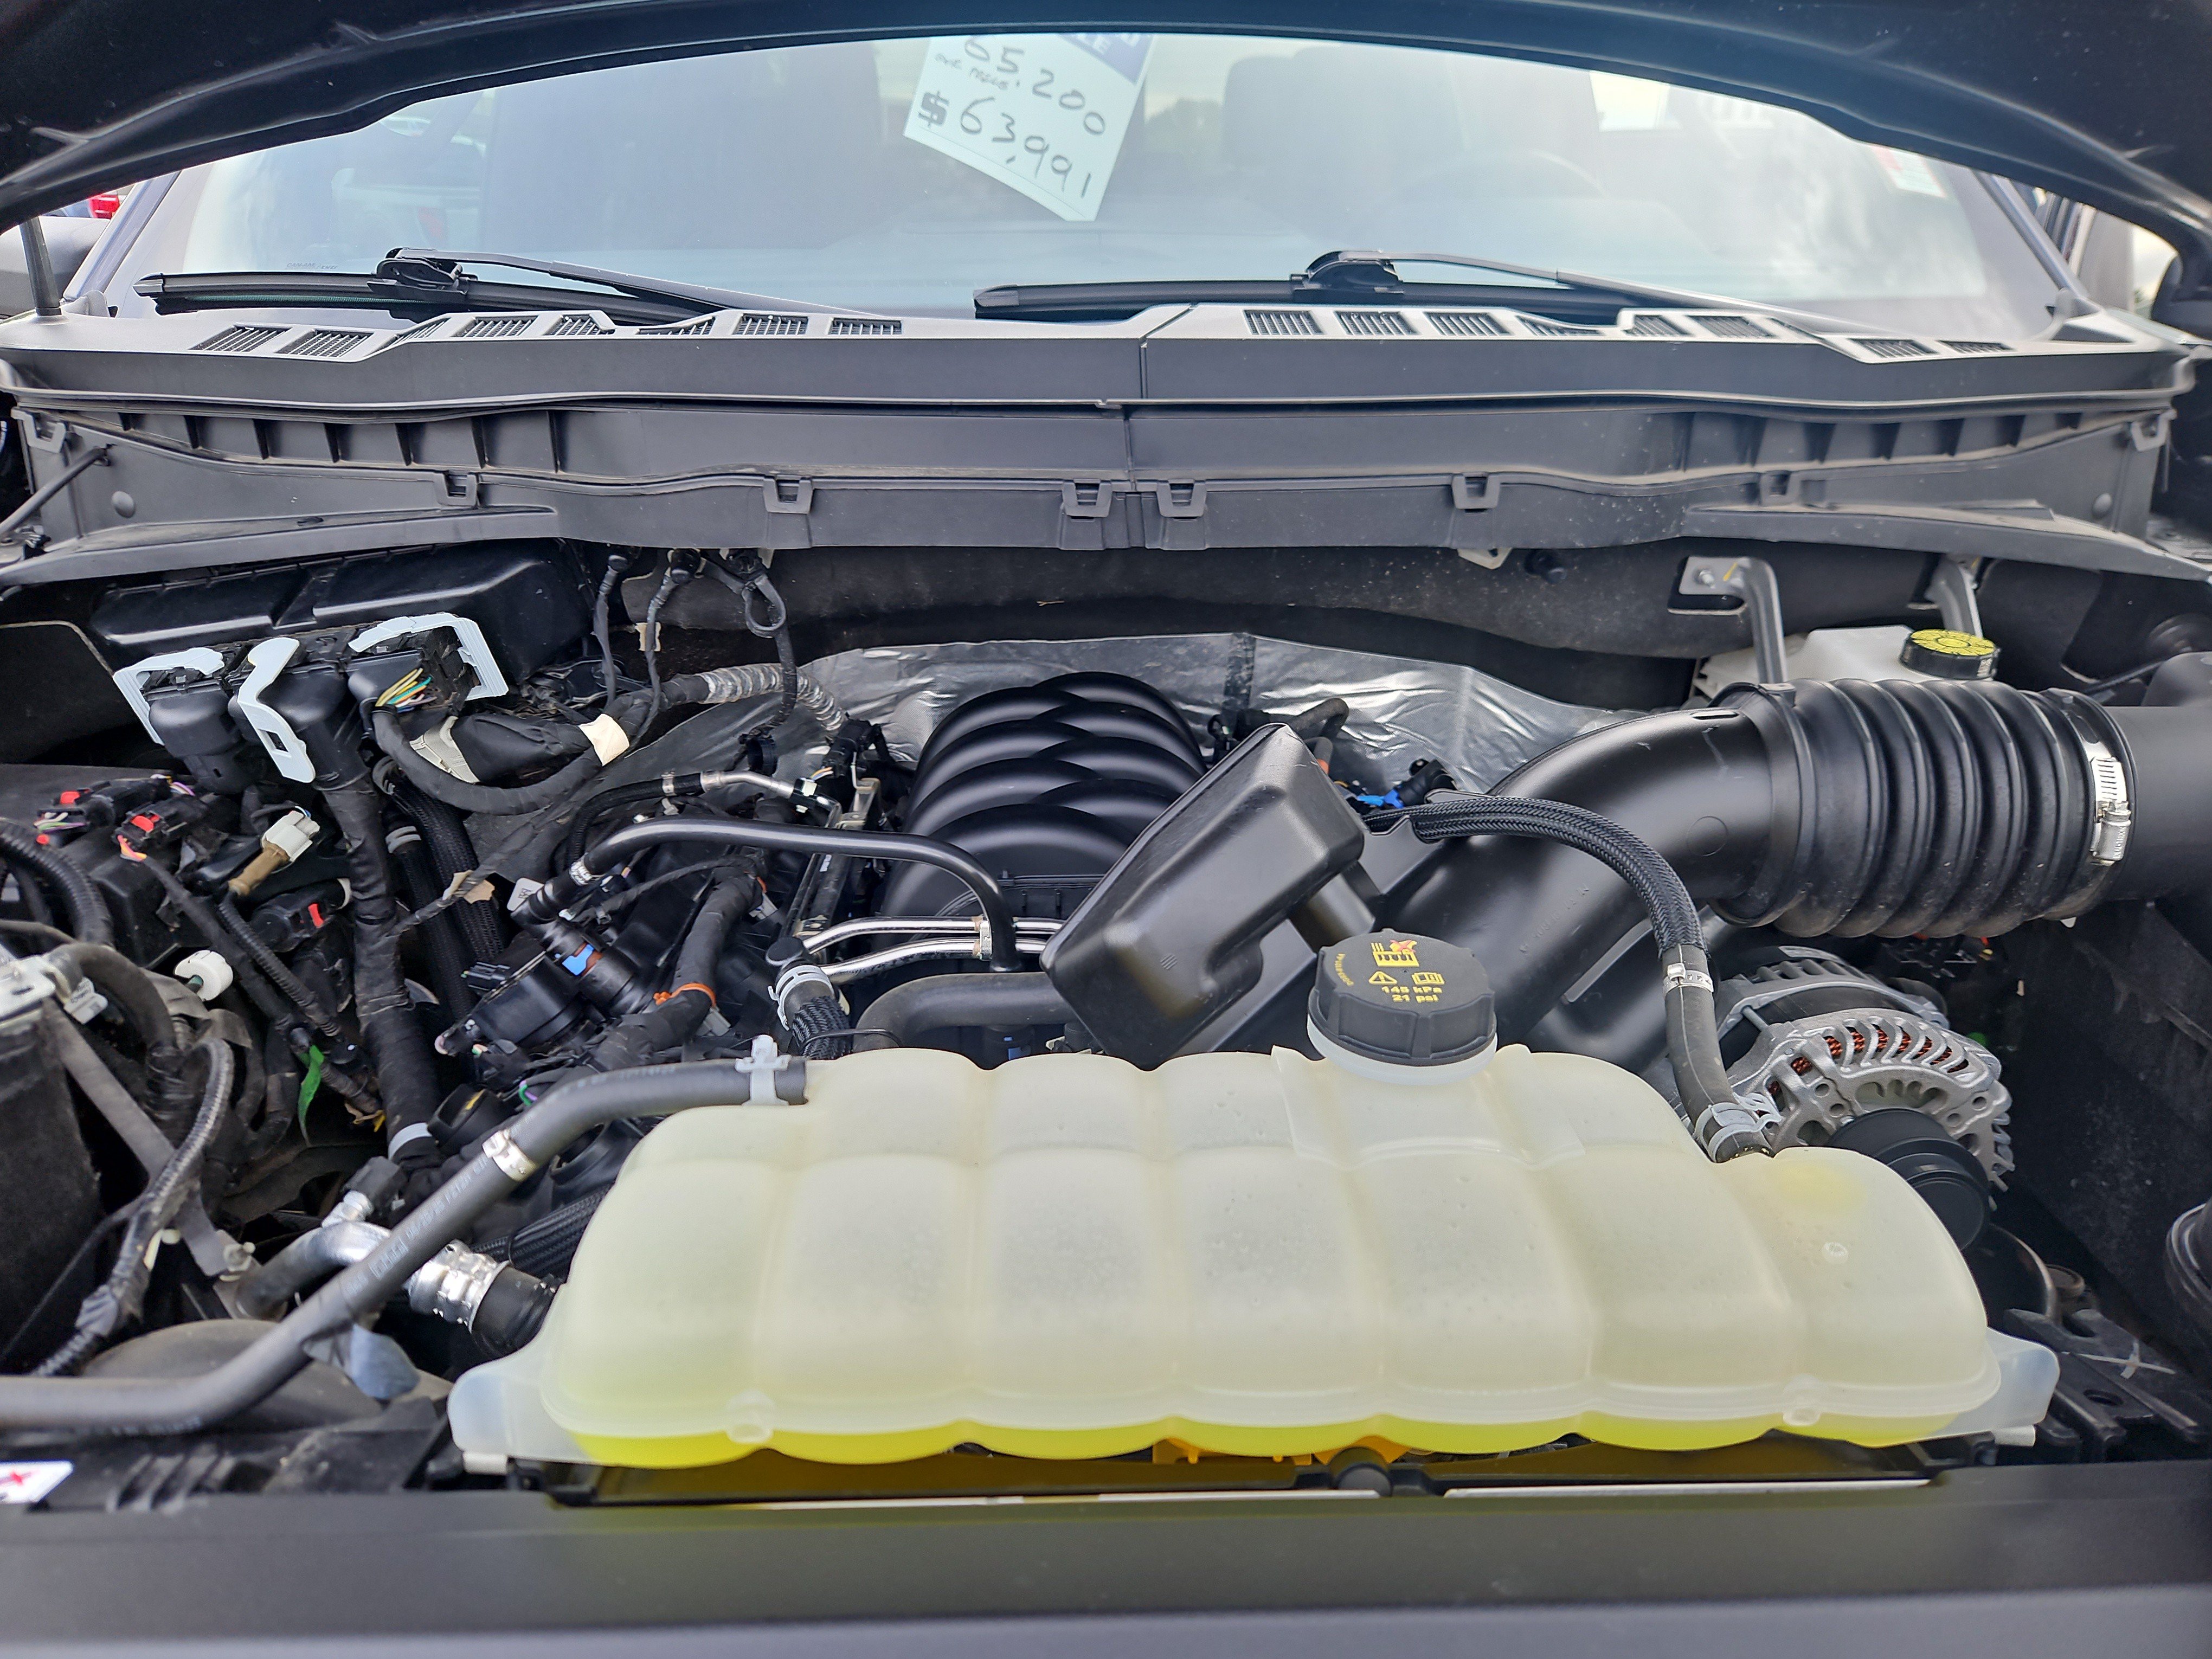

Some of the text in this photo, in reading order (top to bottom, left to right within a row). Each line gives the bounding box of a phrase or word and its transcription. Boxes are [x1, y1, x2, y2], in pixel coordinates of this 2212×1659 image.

[1381, 986, 1443, 994] 145 kPa
[1391, 994, 1439, 1004] 21 psi
